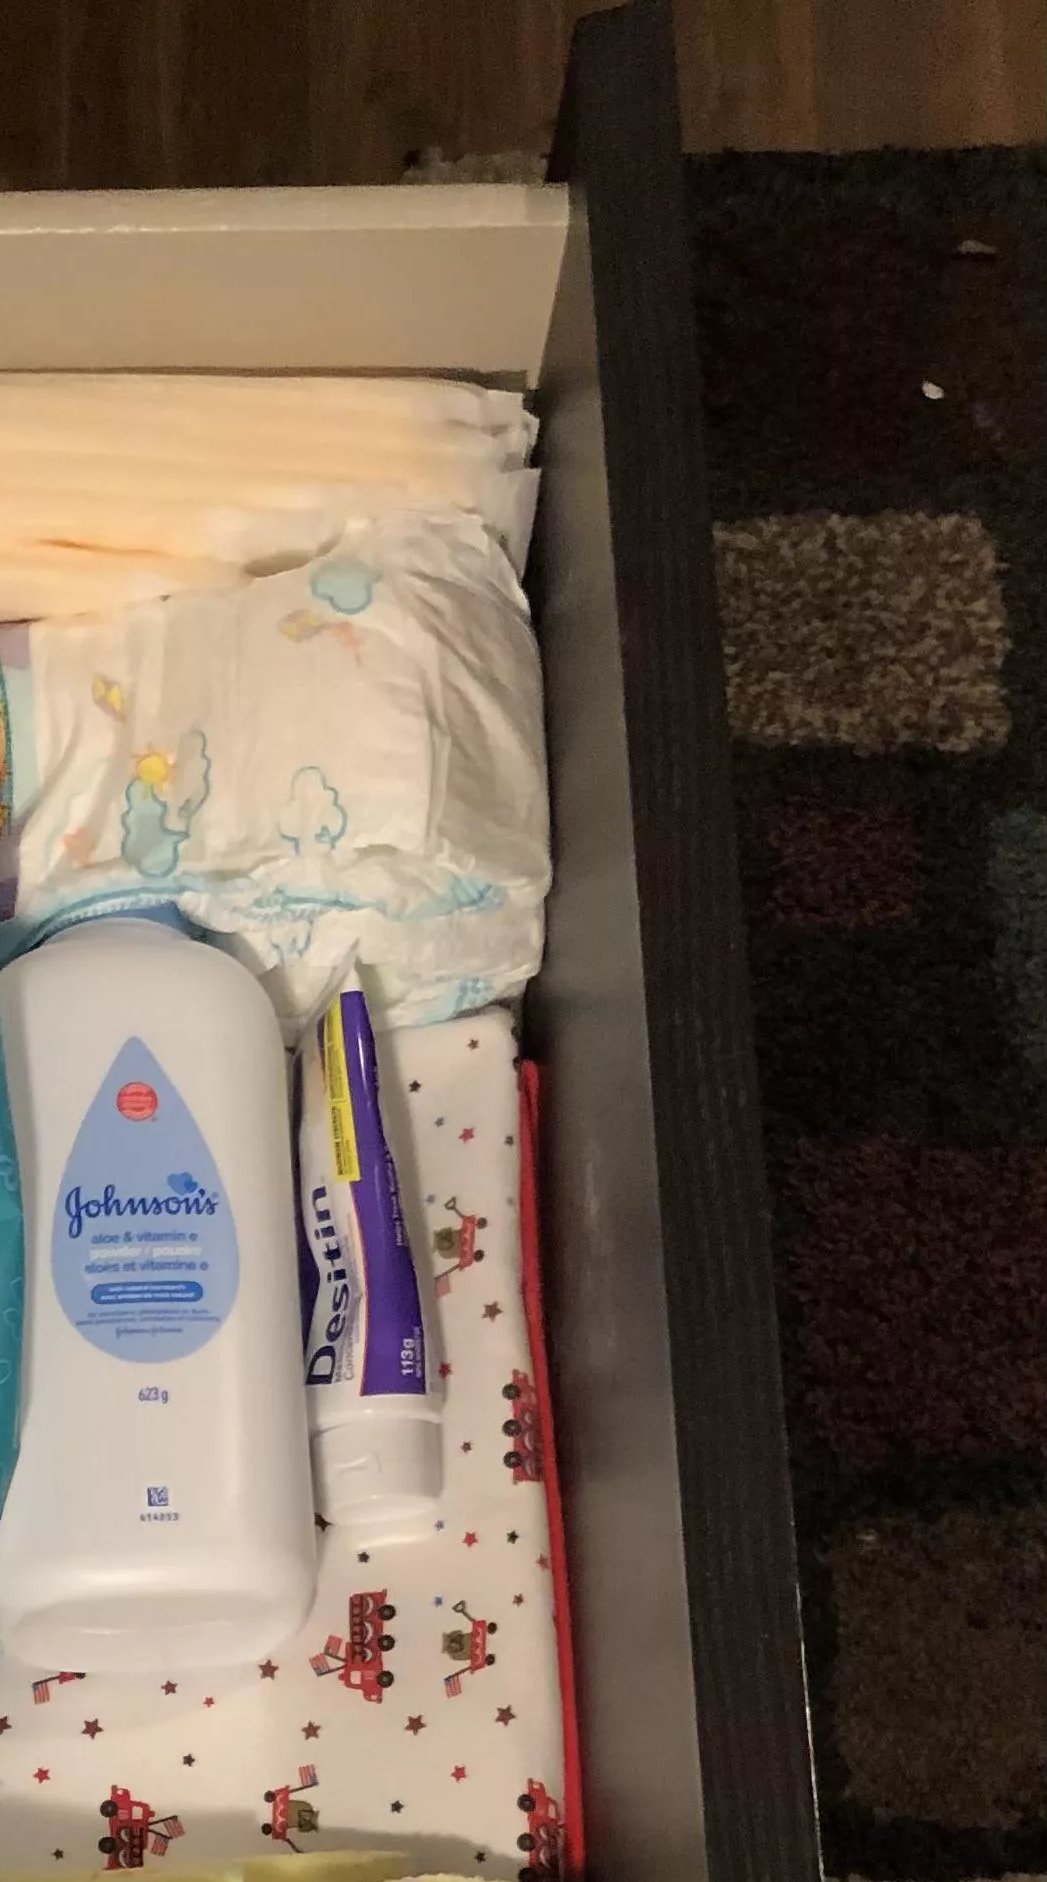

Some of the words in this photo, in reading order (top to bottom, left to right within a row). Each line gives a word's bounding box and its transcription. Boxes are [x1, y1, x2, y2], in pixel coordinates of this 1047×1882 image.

[65, 1184, 218, 1239] Johnson's
[91, 1232, 120, 1244] aloe
[122, 1231, 134, 1243] &
[136, 1230, 186, 1242] vitamin
[189, 1232, 198, 1242] e
[139, 1259, 196, 1272] vitamine
[305, 1186, 350, 1385] Desitin
[138, 1387, 160, 1402] 623
